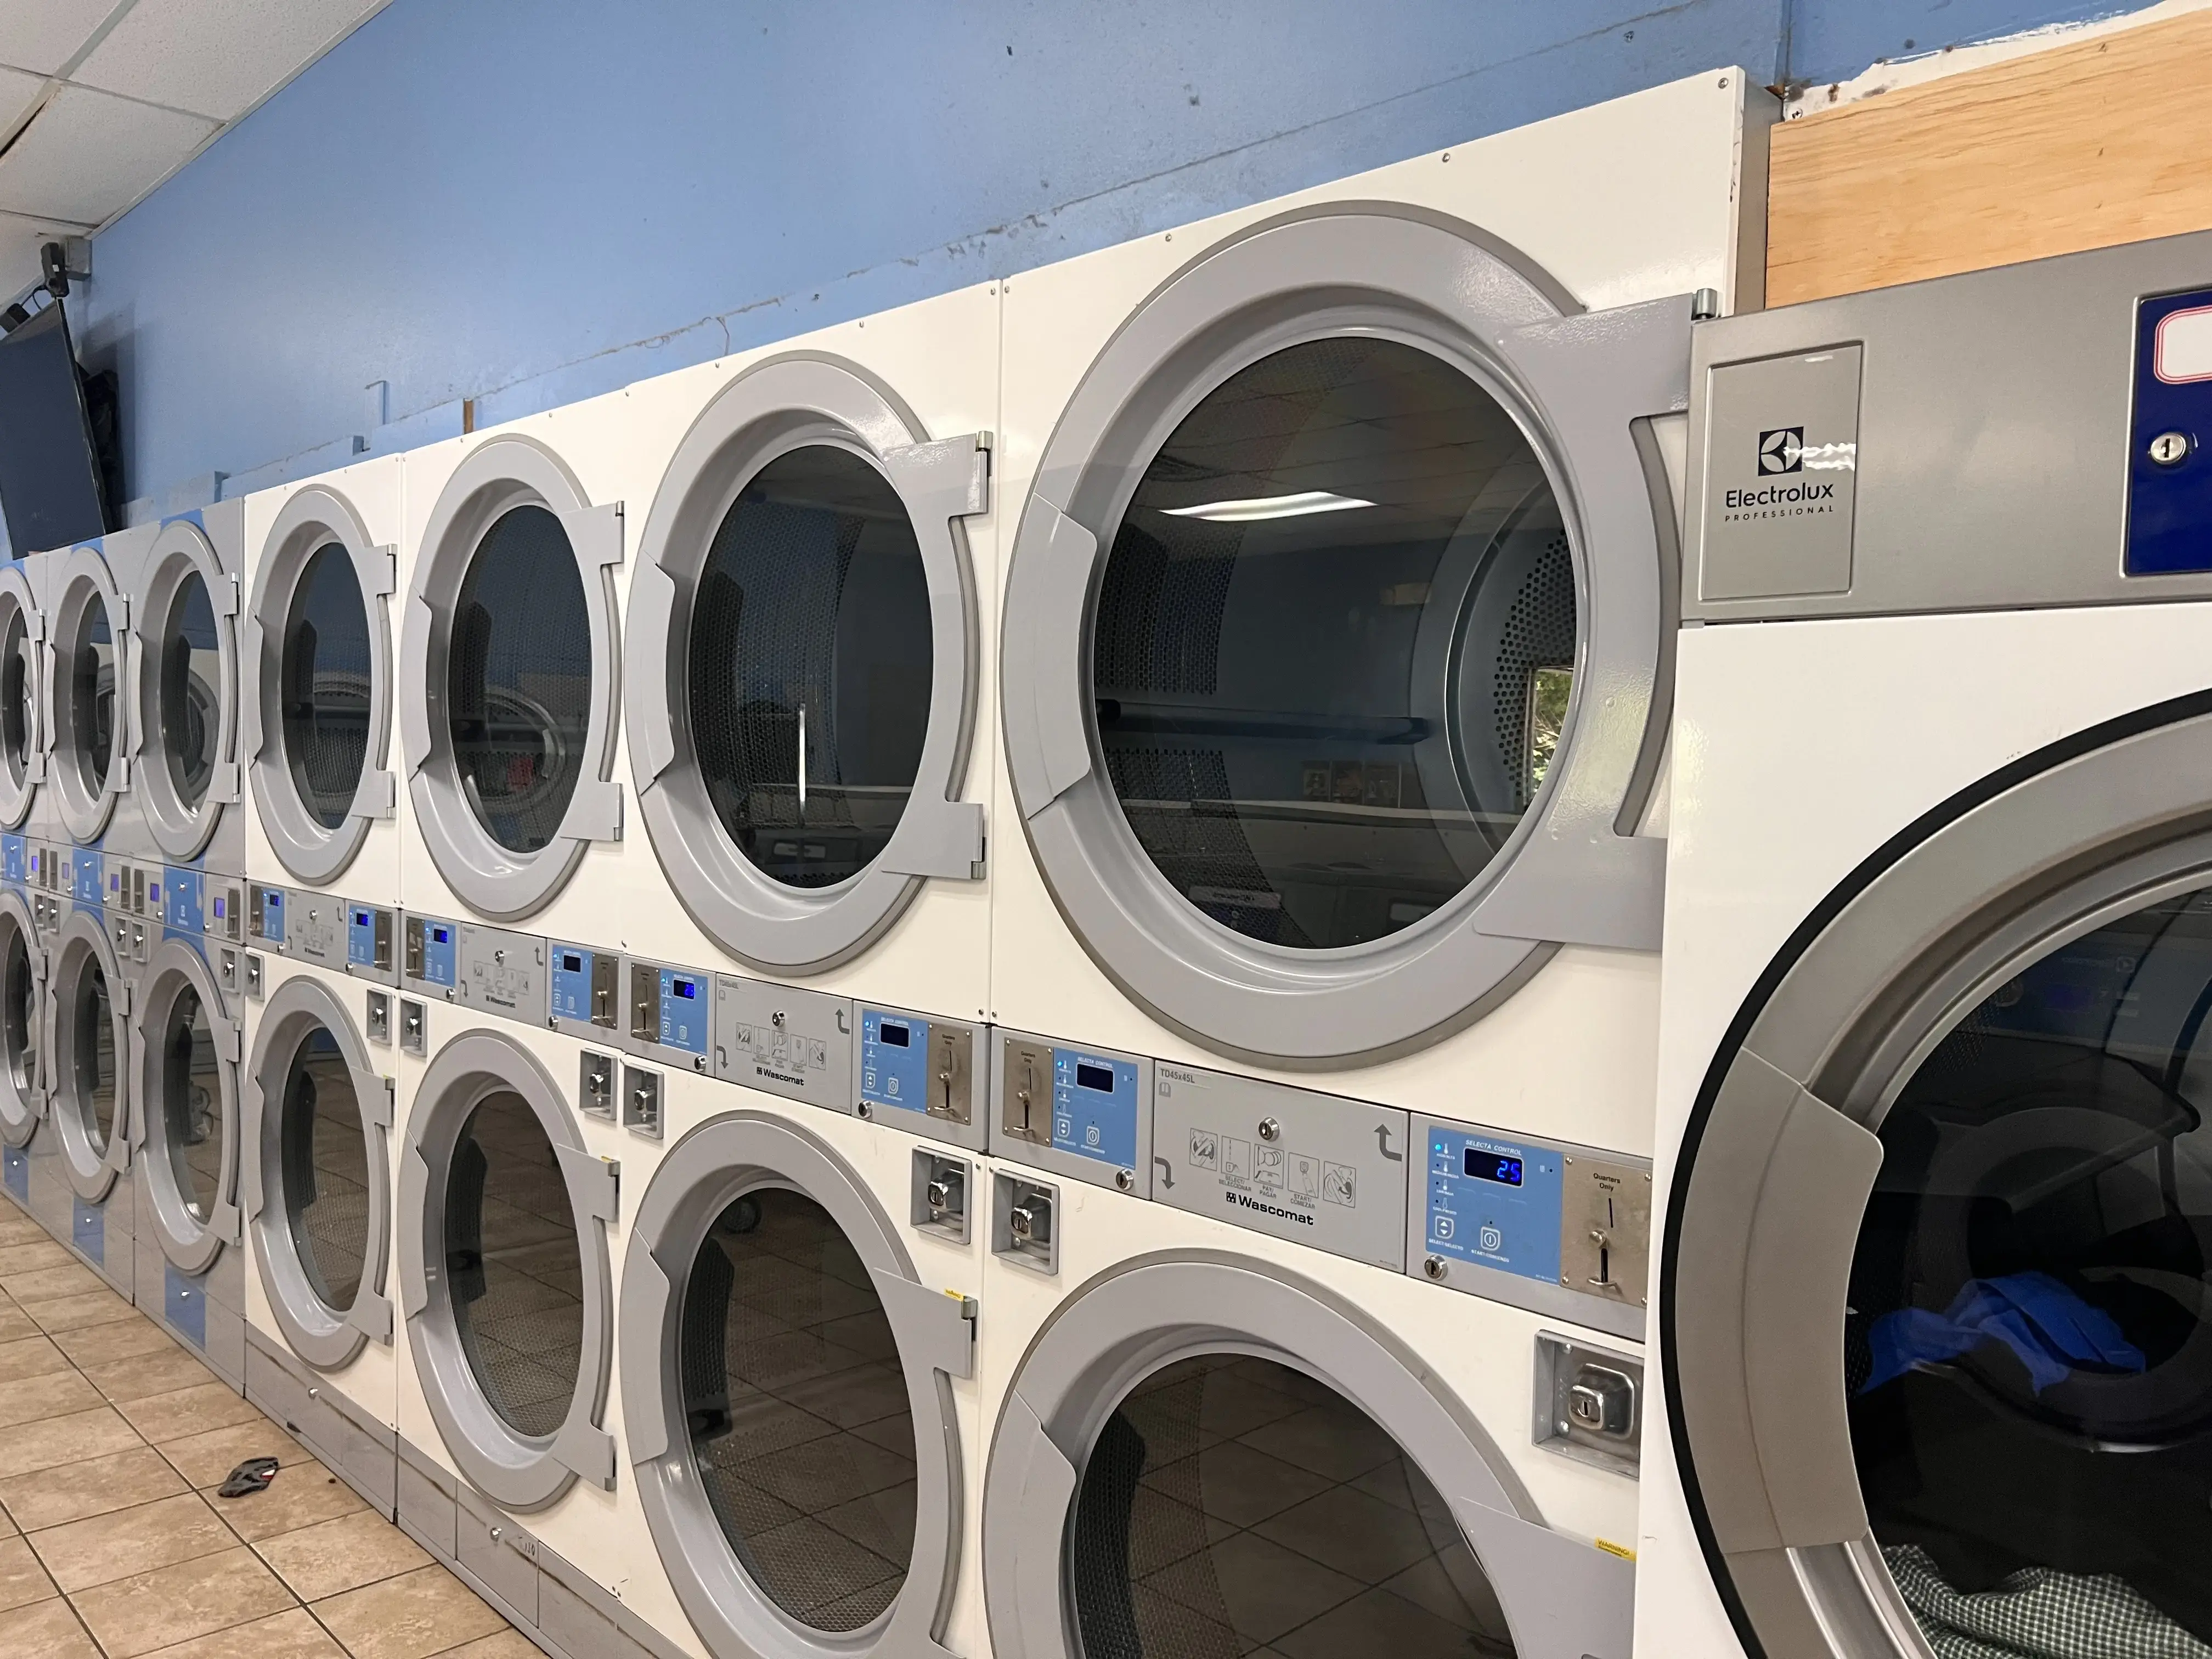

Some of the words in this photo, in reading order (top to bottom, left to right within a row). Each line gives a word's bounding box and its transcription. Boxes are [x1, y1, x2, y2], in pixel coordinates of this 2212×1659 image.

[1726, 483, 1833, 508] Electrolux
[1725, 505, 1833, 522] PROFESSIONAL
[763, 1068, 804, 1086] Wascomat
[1465, 1139, 1492, 1150] SELECTA
[1494, 1145, 1522, 1156] CONTROL
[1497, 1160, 1521, 1182] 25
[1593, 1172, 1621, 1184] Quarters
[1259, 1189, 1277, 1199] PAGAR
[1599, 1182, 1614, 1192] Only
[1238, 1194, 1313, 1226] Wascomat
